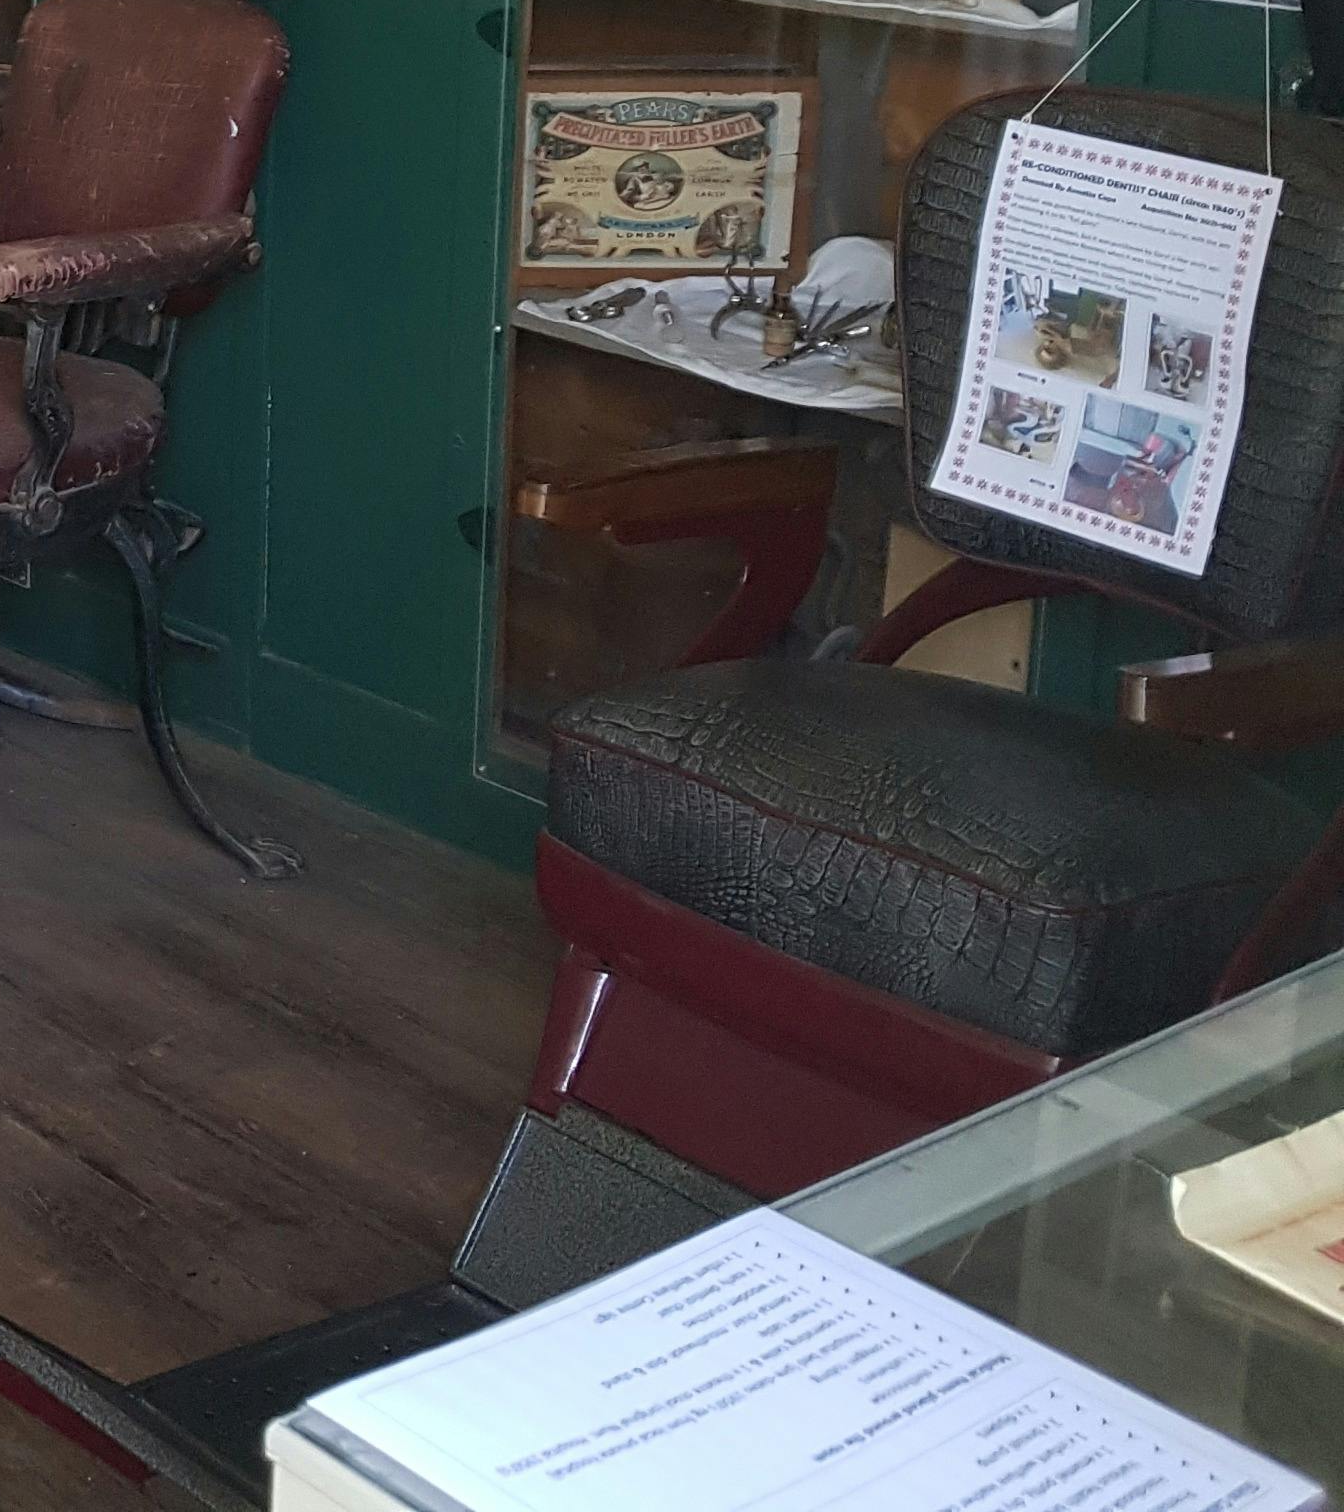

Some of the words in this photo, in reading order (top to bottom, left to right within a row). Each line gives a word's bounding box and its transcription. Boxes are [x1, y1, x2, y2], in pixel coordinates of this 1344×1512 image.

[619, 102, 688, 120] PEARS
[553, 117, 645, 146] PRECIPITATED
[648, 127, 708, 146] FULLER'S
[712, 118, 757, 137] EARTH
[1021, 159, 1105, 186] RE-CONDITIONED
[1106, 177, 1147, 194] DENTIST
[1148, 188, 1180, 204] CHAIR
[966, 1353, 1011, 1378] Medical
[901, 1390, 938, 1415] placed
[862, 1411, 902, 1436] around
[843, 1433, 866, 1446] the
[812, 1444, 844, 1462] room
